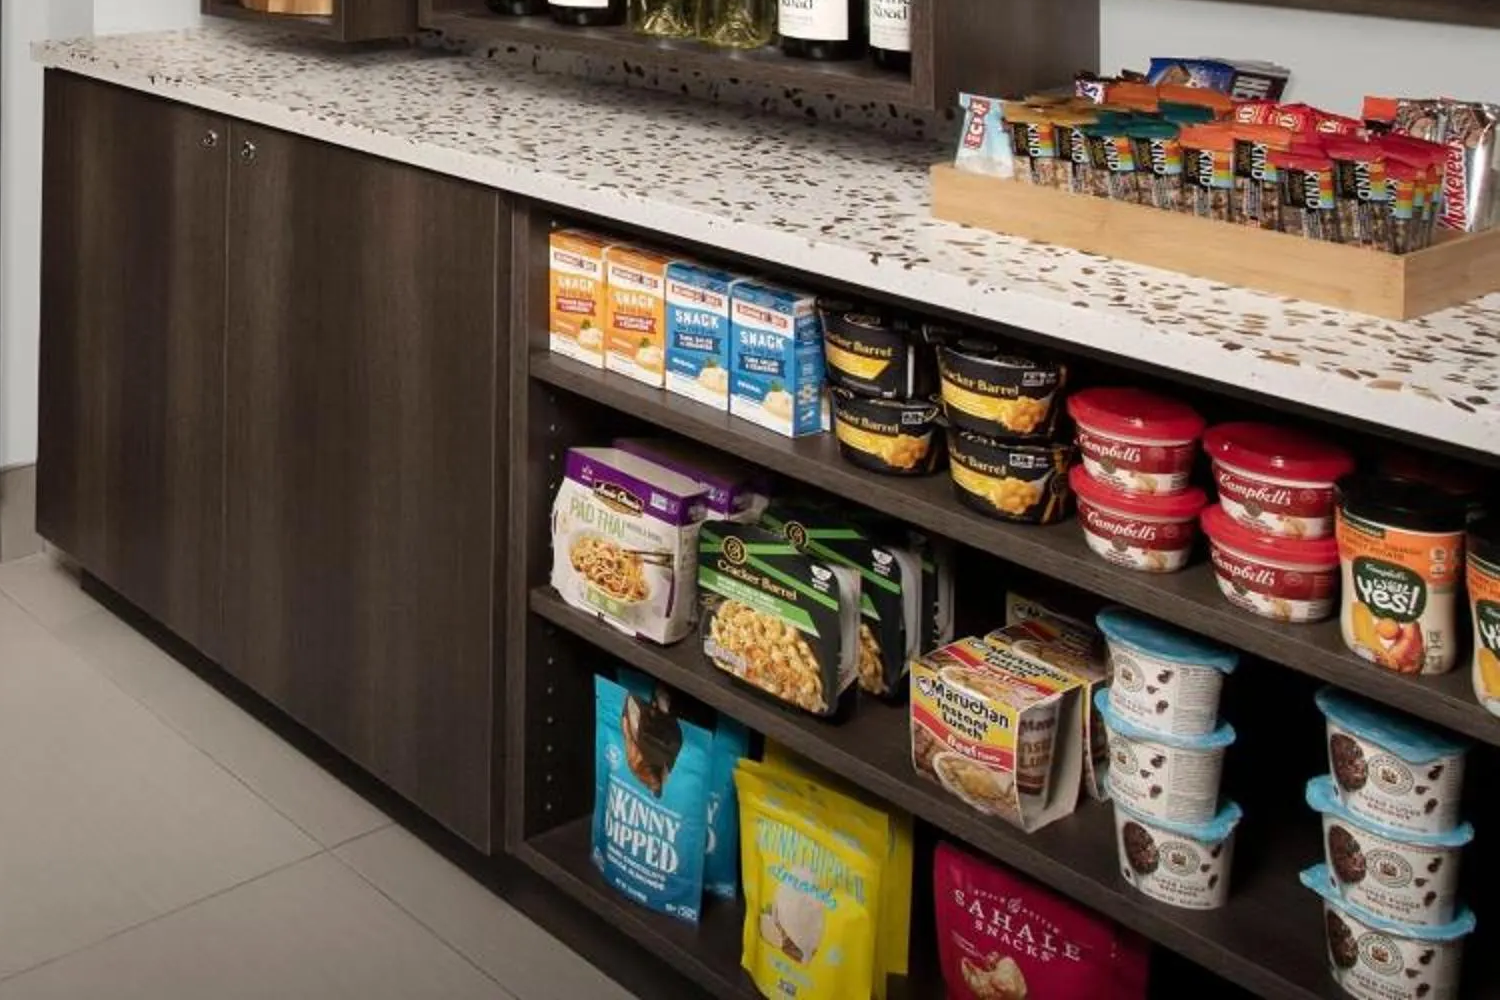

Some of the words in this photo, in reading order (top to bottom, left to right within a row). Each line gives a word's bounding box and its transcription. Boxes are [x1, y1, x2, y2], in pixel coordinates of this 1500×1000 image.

[1027, 124, 1041, 157] KIND
[1071, 128, 1084, 163] KIND
[1104, 136, 1118, 171] KIND
[1151, 139, 1165, 174] KIND
[1200, 151, 1213, 187] KIND
[1252, 143, 1268, 180] KIND
[1304, 171, 1320, 209] KIND
[1354, 160, 1372, 200] KIND
[675, 309, 720, 329] SNACK
[739, 331, 785, 350] SNACK
[853, 342, 893, 358] Barrel
[977, 379, 1019, 396] Barrel
[861, 416, 900, 433] Barrel
[968, 455, 1007, 475] Barrel
[1076, 432, 1141, 463] Campbell's
[1219, 472, 1292, 506] Campbell's
[570, 498, 596, 524] PAD
[596, 509, 626, 538] THAI
[1086, 507, 1157, 541] Campbell's
[716, 558, 761, 586] Cracker
[760, 576, 798, 601] Barrel
[1212, 549, 1276, 587] Campbell's
[1356, 574, 1421, 615] Yes!
[931, 678, 1010, 729] Maruchan
[936, 698, 989, 733] Instant
[942, 713, 983, 741] Lunch
[609, 782, 682, 844] SKINNY
[605, 811, 680, 874] DIPPED
[952, 888, 1082, 963] SAHALE
[974, 918, 1057, 964] SNACKS
